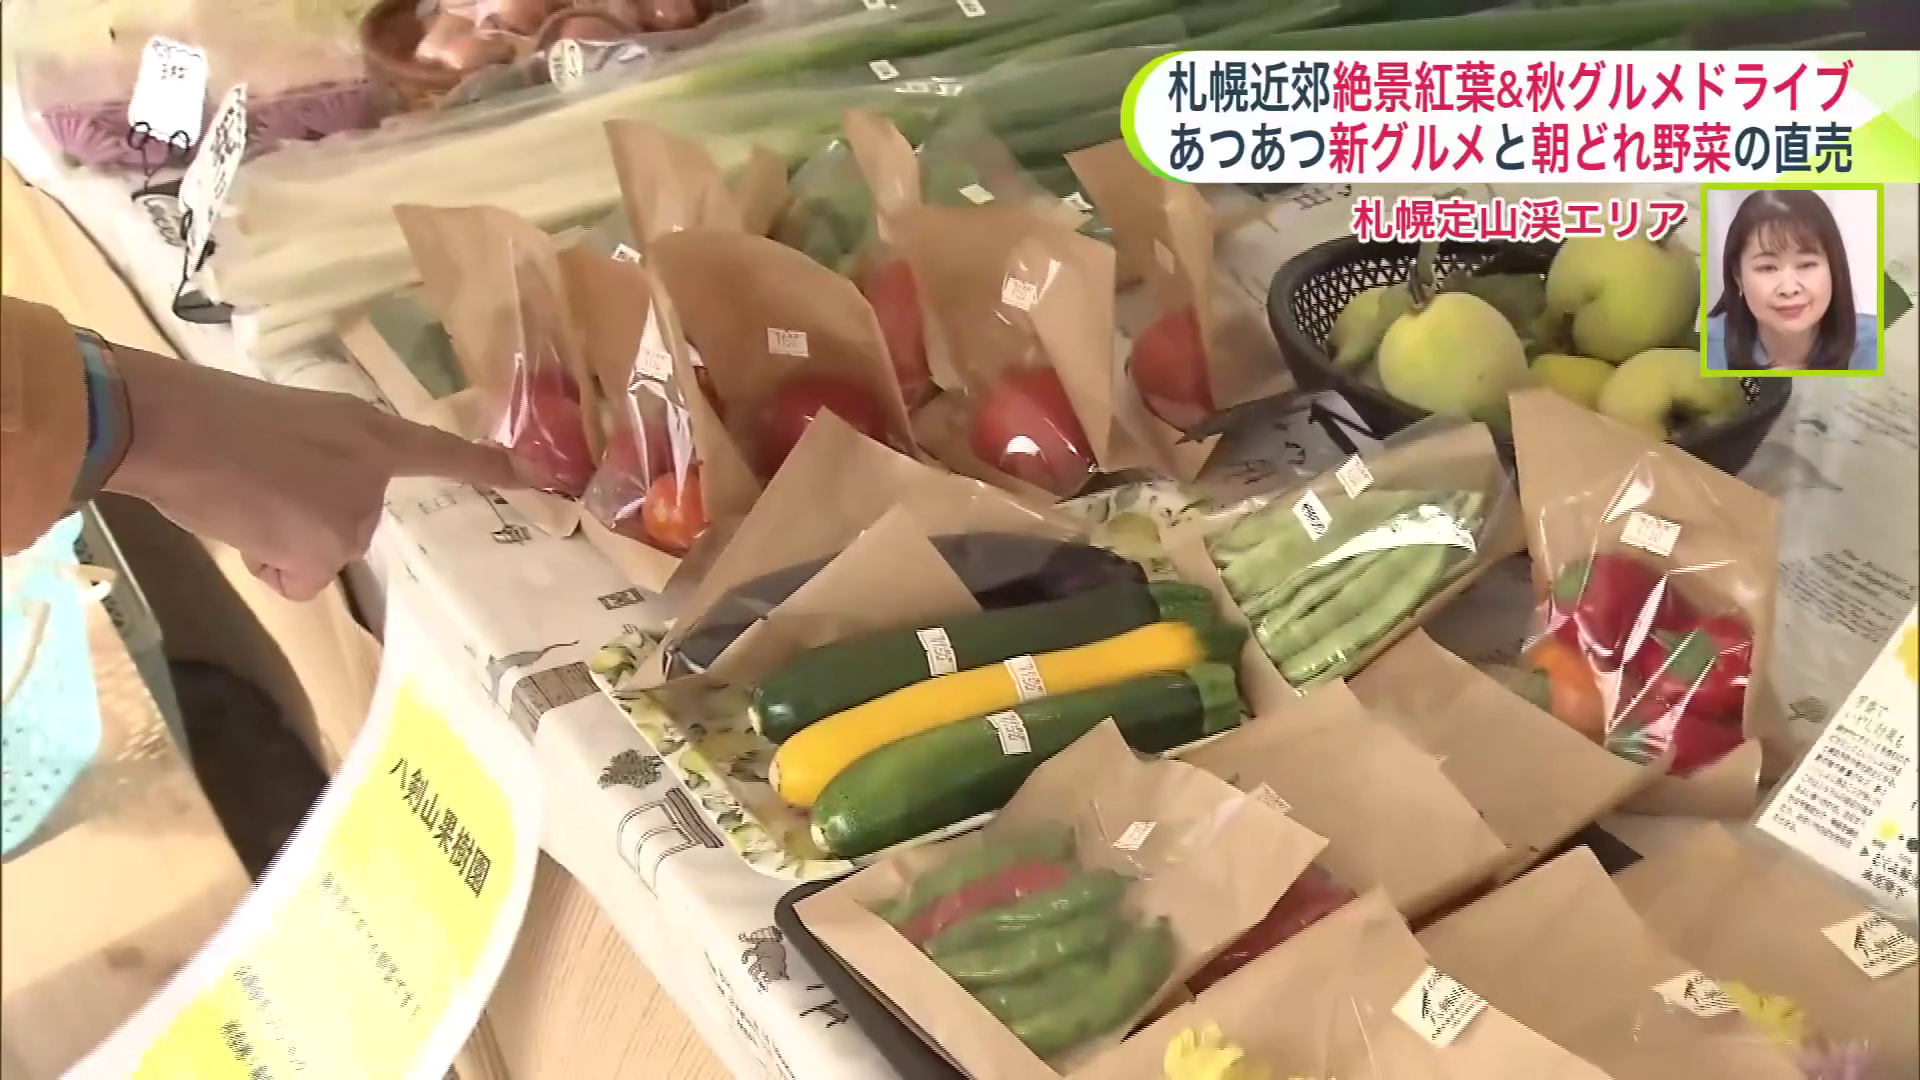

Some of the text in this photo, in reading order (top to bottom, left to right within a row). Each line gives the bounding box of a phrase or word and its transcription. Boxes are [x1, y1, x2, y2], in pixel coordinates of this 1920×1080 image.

[388, 757, 491, 898] 八剣山果樹園
